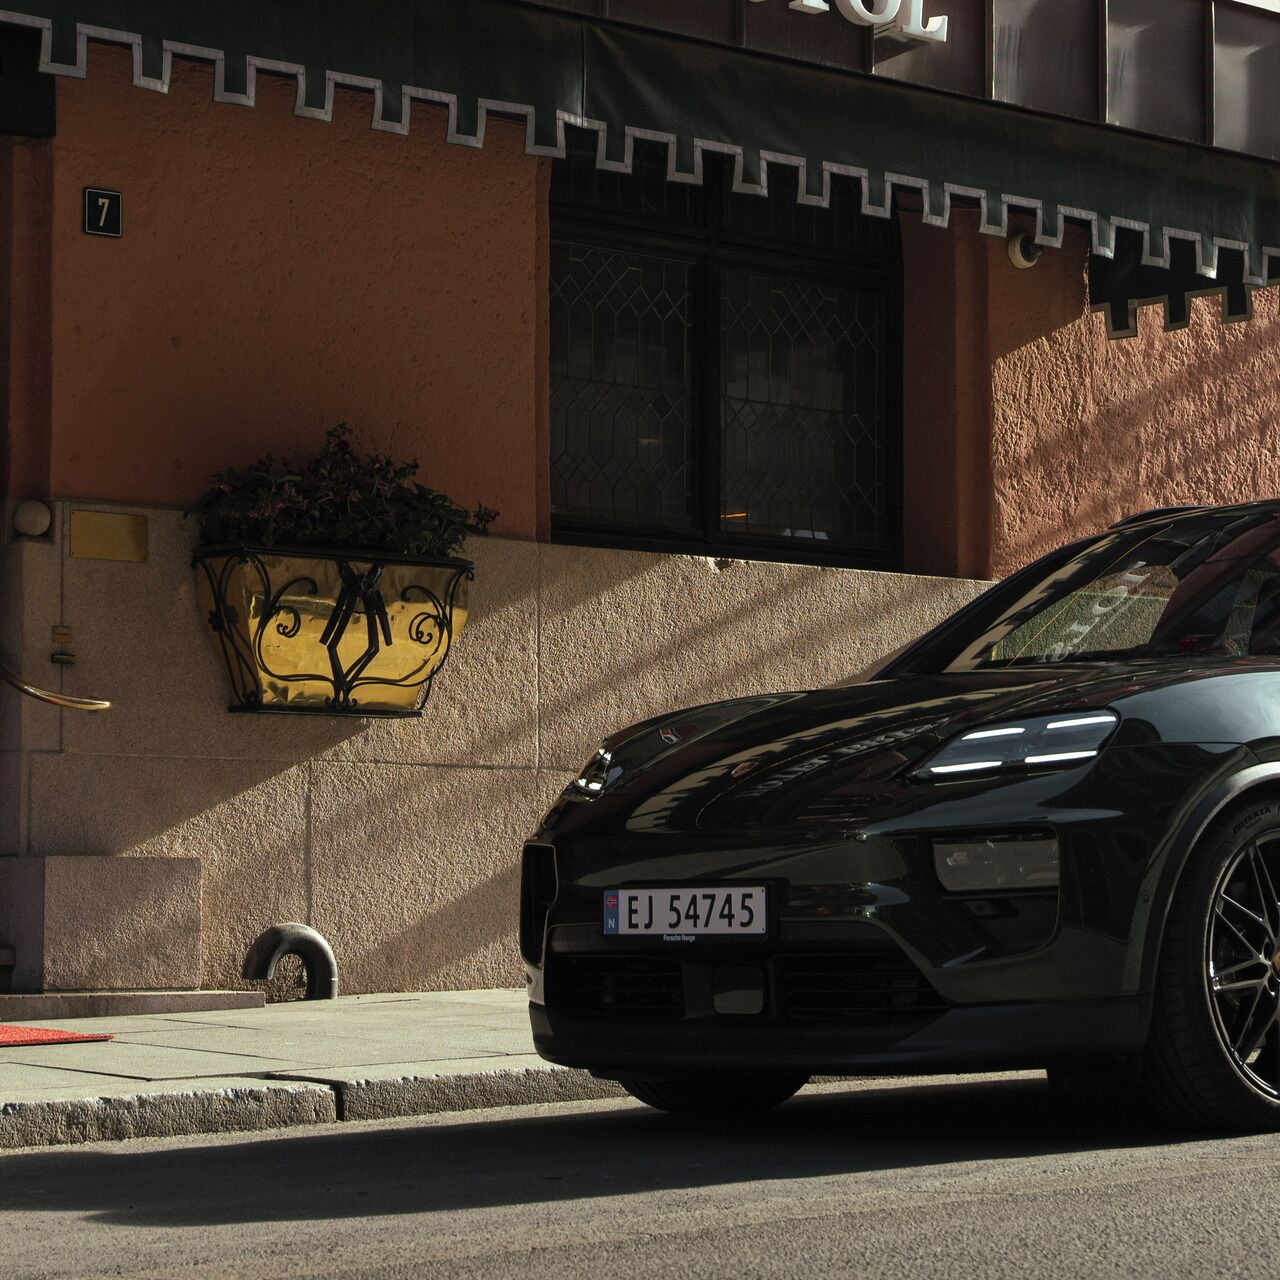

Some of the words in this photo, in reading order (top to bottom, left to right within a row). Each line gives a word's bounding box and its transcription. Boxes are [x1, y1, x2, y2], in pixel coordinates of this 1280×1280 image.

[98, 197, 110, 227] 7
[608, 918, 615, 929] N
[628, 895, 653, 929] EJ
[669, 893, 754, 929] 54745
